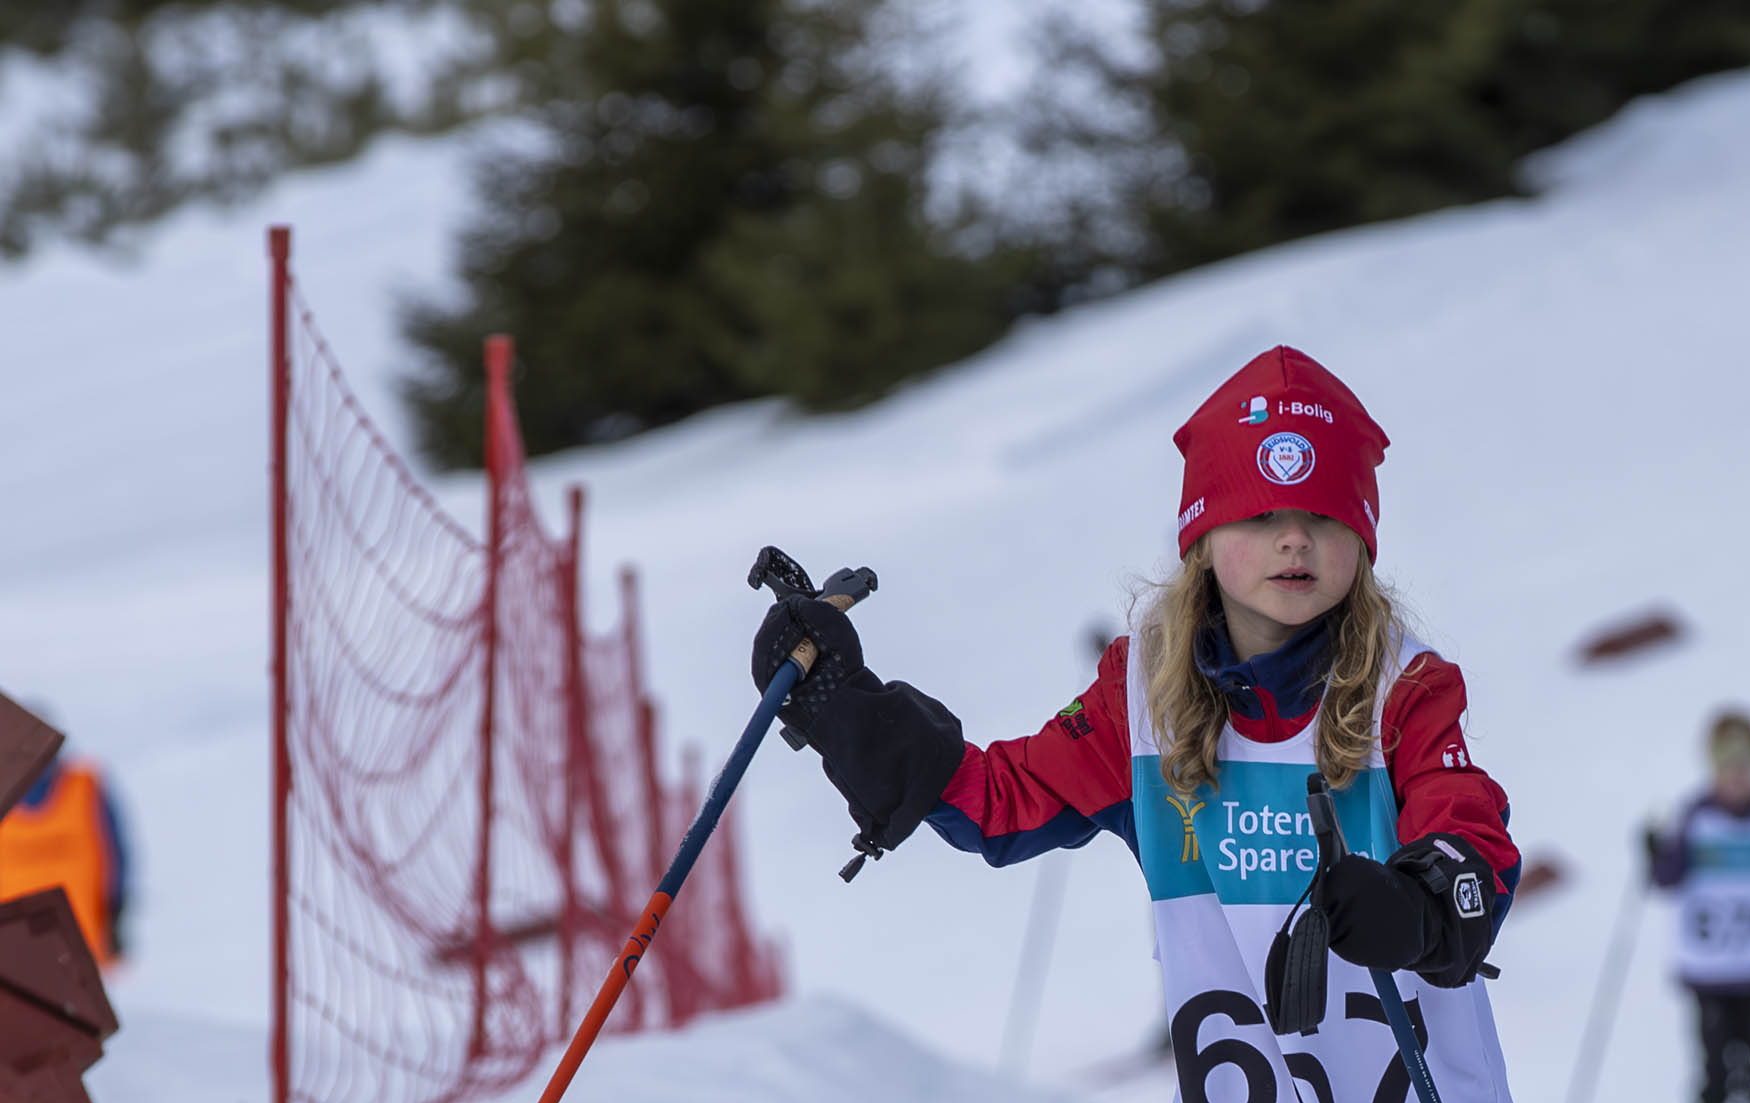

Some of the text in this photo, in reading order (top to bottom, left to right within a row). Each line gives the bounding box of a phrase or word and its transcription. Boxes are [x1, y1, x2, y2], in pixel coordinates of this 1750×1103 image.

[1278, 400, 1334, 424] i-Bolig
[1222, 801, 1316, 836] Toten
[1218, 838, 1378, 881] Spare
